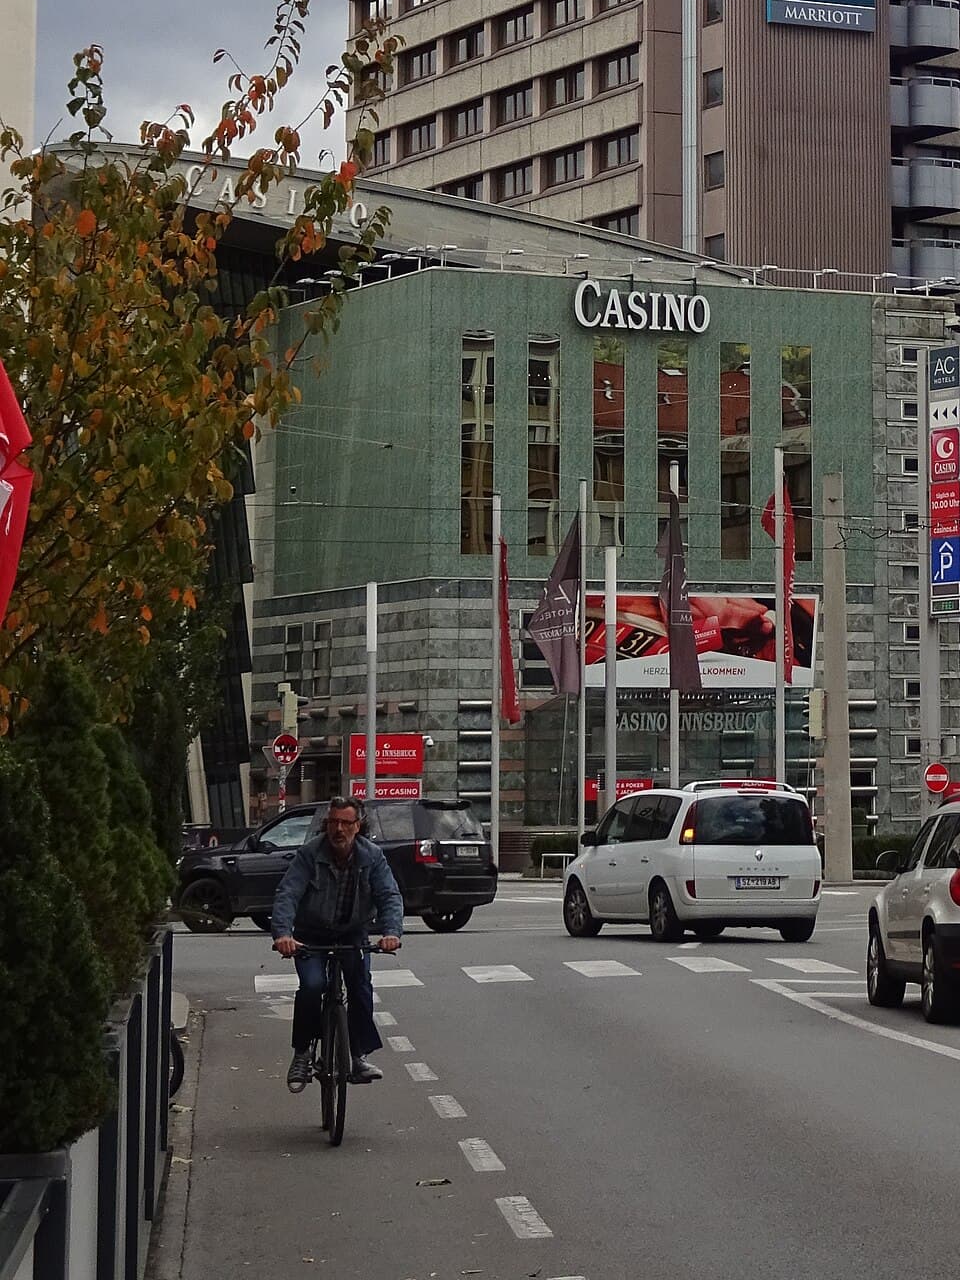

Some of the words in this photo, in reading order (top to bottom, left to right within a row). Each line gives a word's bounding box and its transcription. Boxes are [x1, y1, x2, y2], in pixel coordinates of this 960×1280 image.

[784, 5, 863, 25] MARRIOTT
[185, 165, 368, 229] CASIO
[934, 356, 956, 377] AC
[933, 376, 956, 385] HOTELS
[934, 462, 957, 475] CASINO
[389, 787, 418, 796] CASINO
